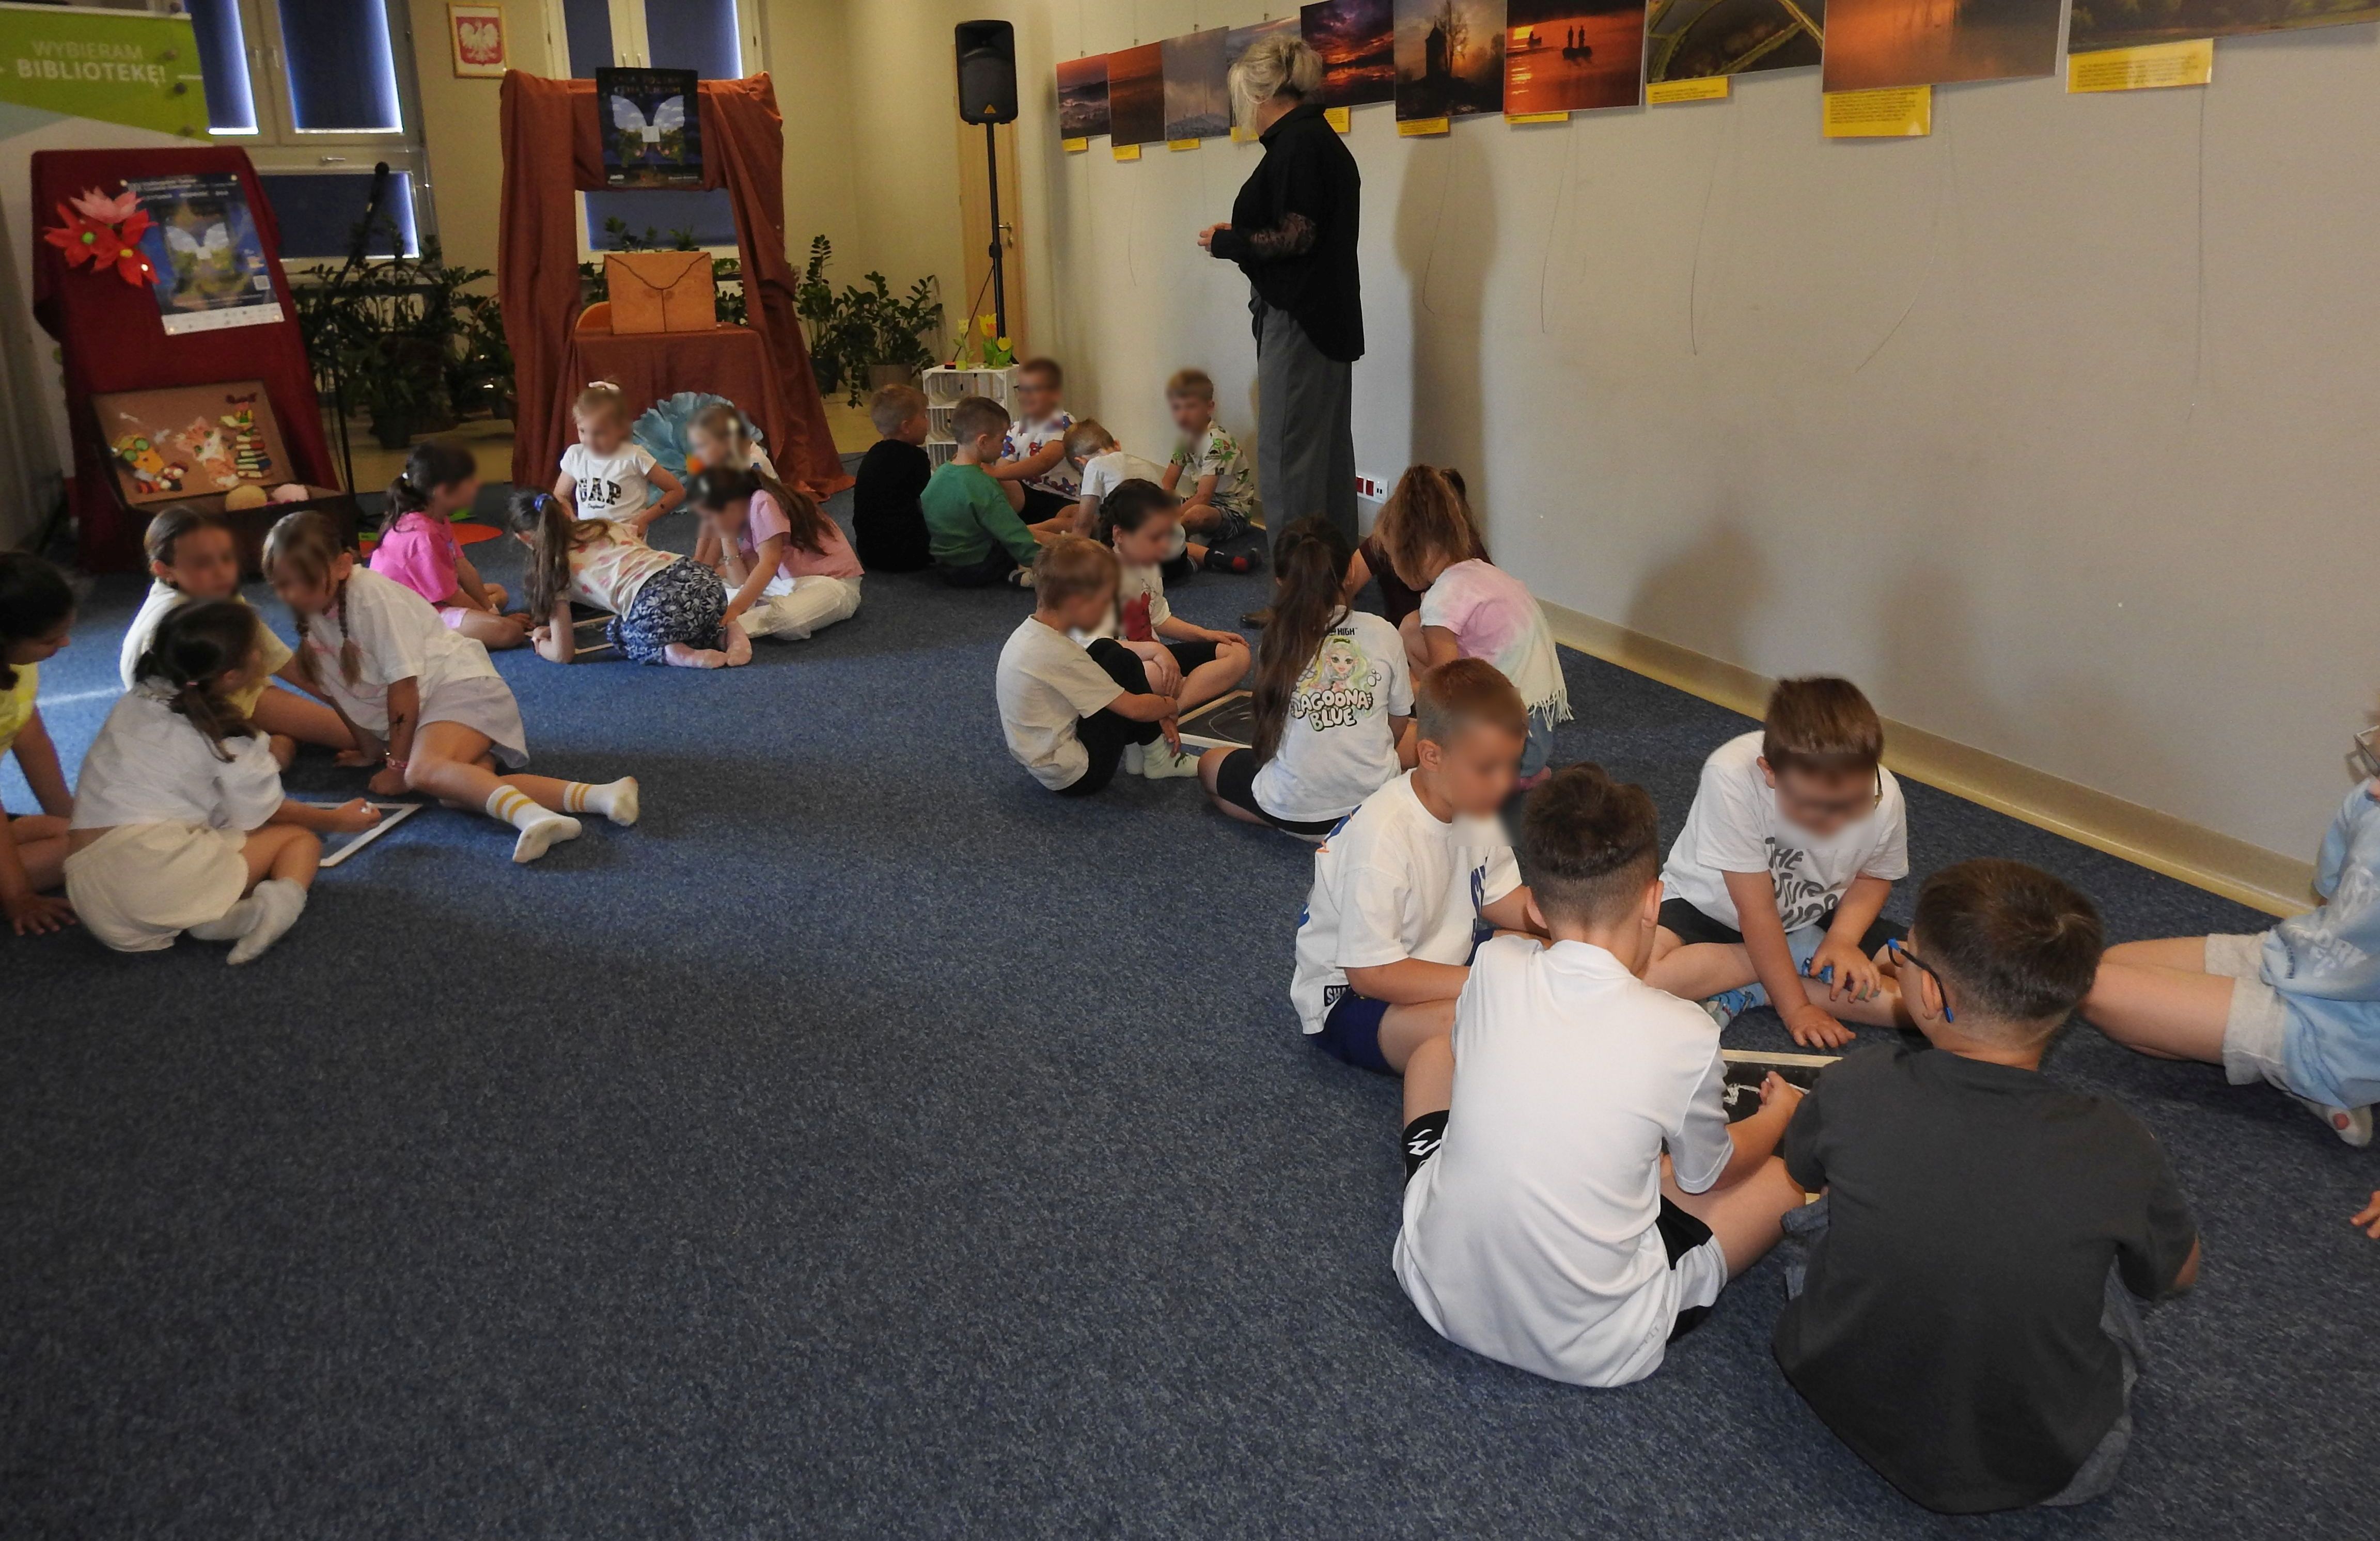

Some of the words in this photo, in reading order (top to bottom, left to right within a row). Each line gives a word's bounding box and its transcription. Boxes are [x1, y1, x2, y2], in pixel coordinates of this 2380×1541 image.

[32, 41, 143, 59] WYBIERAM
[17, 58, 166, 88] BIBLIOTEKĘ!
[578, 477, 621, 505] GAP
[1291, 688, 1370, 719] LAGOONA
[1309, 707, 1357, 732] BLUE
